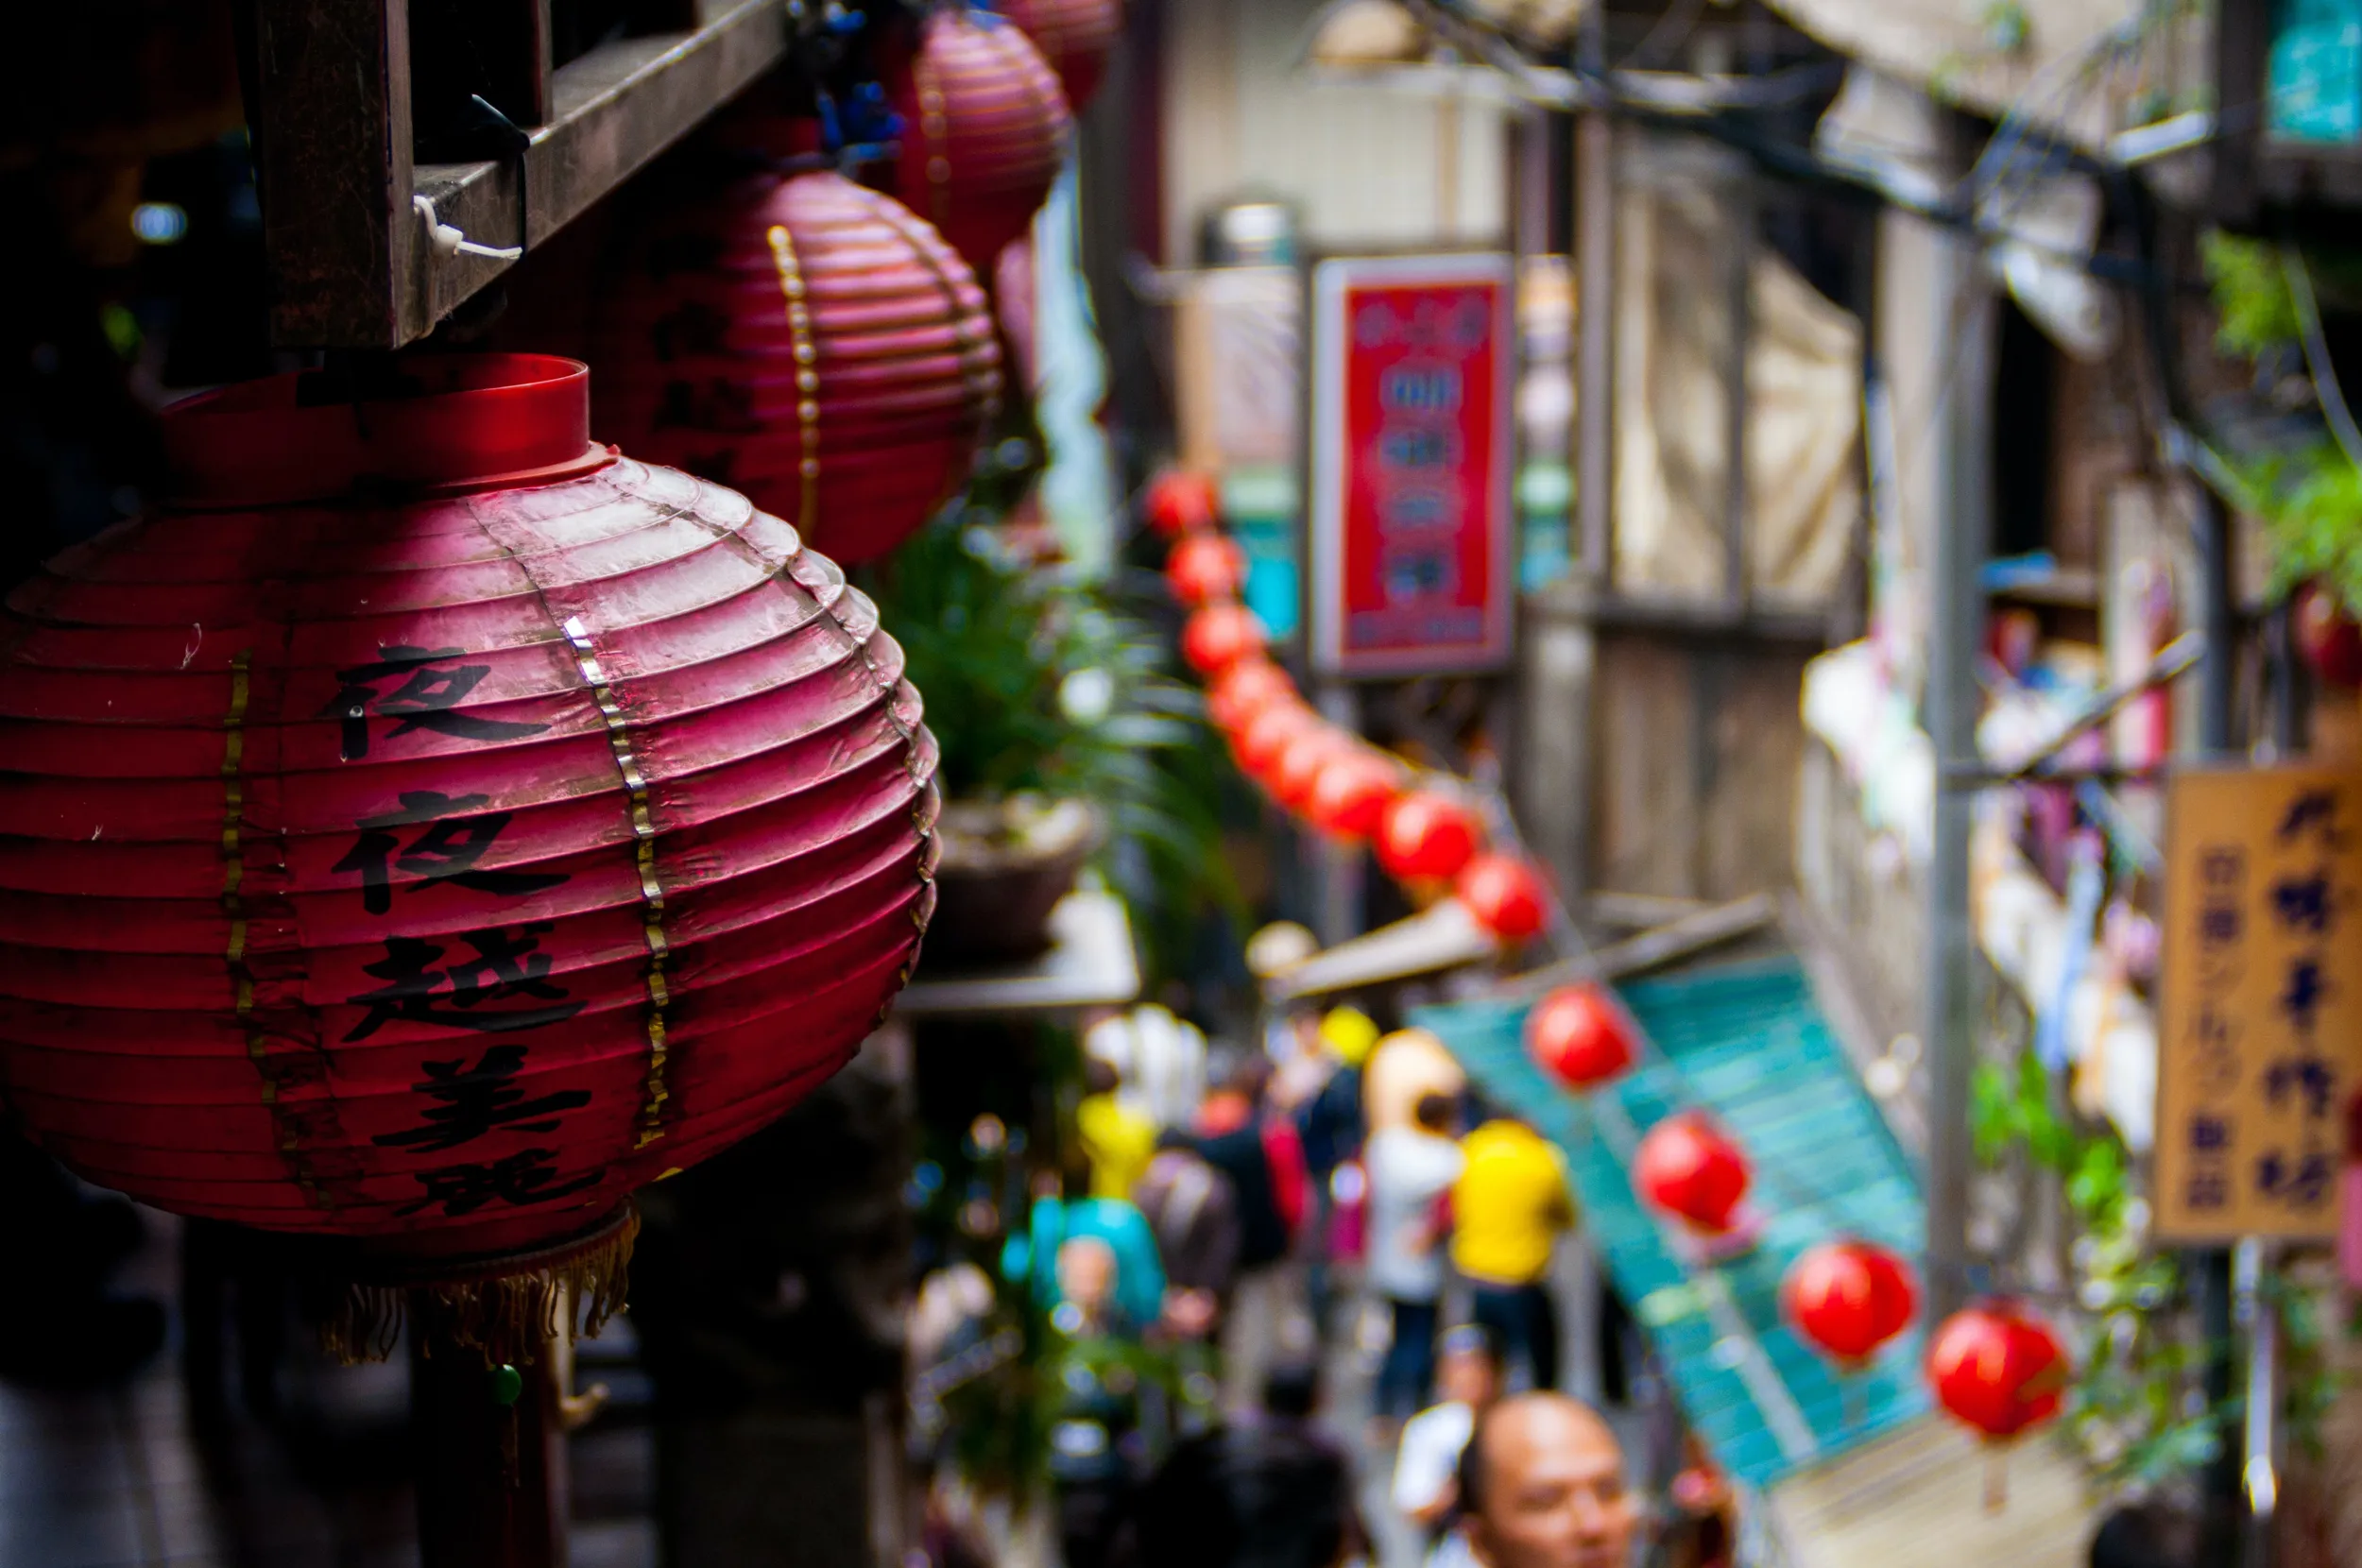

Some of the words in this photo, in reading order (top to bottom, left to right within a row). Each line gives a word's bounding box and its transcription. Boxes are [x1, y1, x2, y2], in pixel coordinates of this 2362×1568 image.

[323, 645, 608, 1218] 夜夜越美麗
